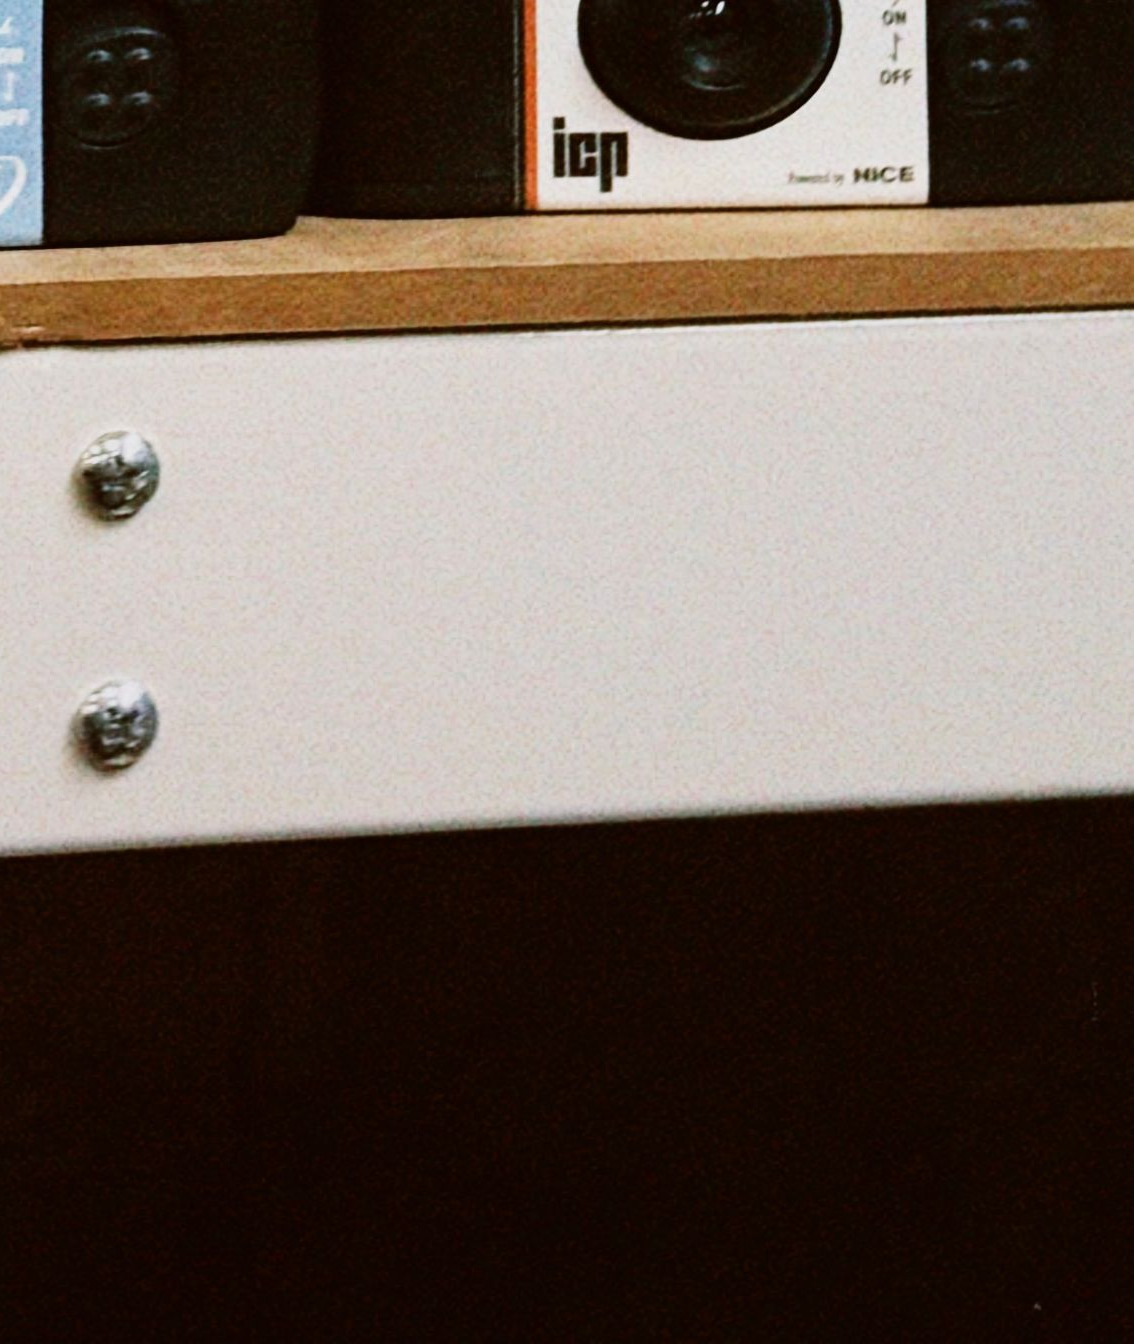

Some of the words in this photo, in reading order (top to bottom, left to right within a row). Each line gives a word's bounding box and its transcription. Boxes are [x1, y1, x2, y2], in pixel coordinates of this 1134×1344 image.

[882, 10, 907, 26] ON
[879, 68, 912, 85] OFF
[553, 117, 628, 192] icp
[853, 165, 915, 184] NICE
